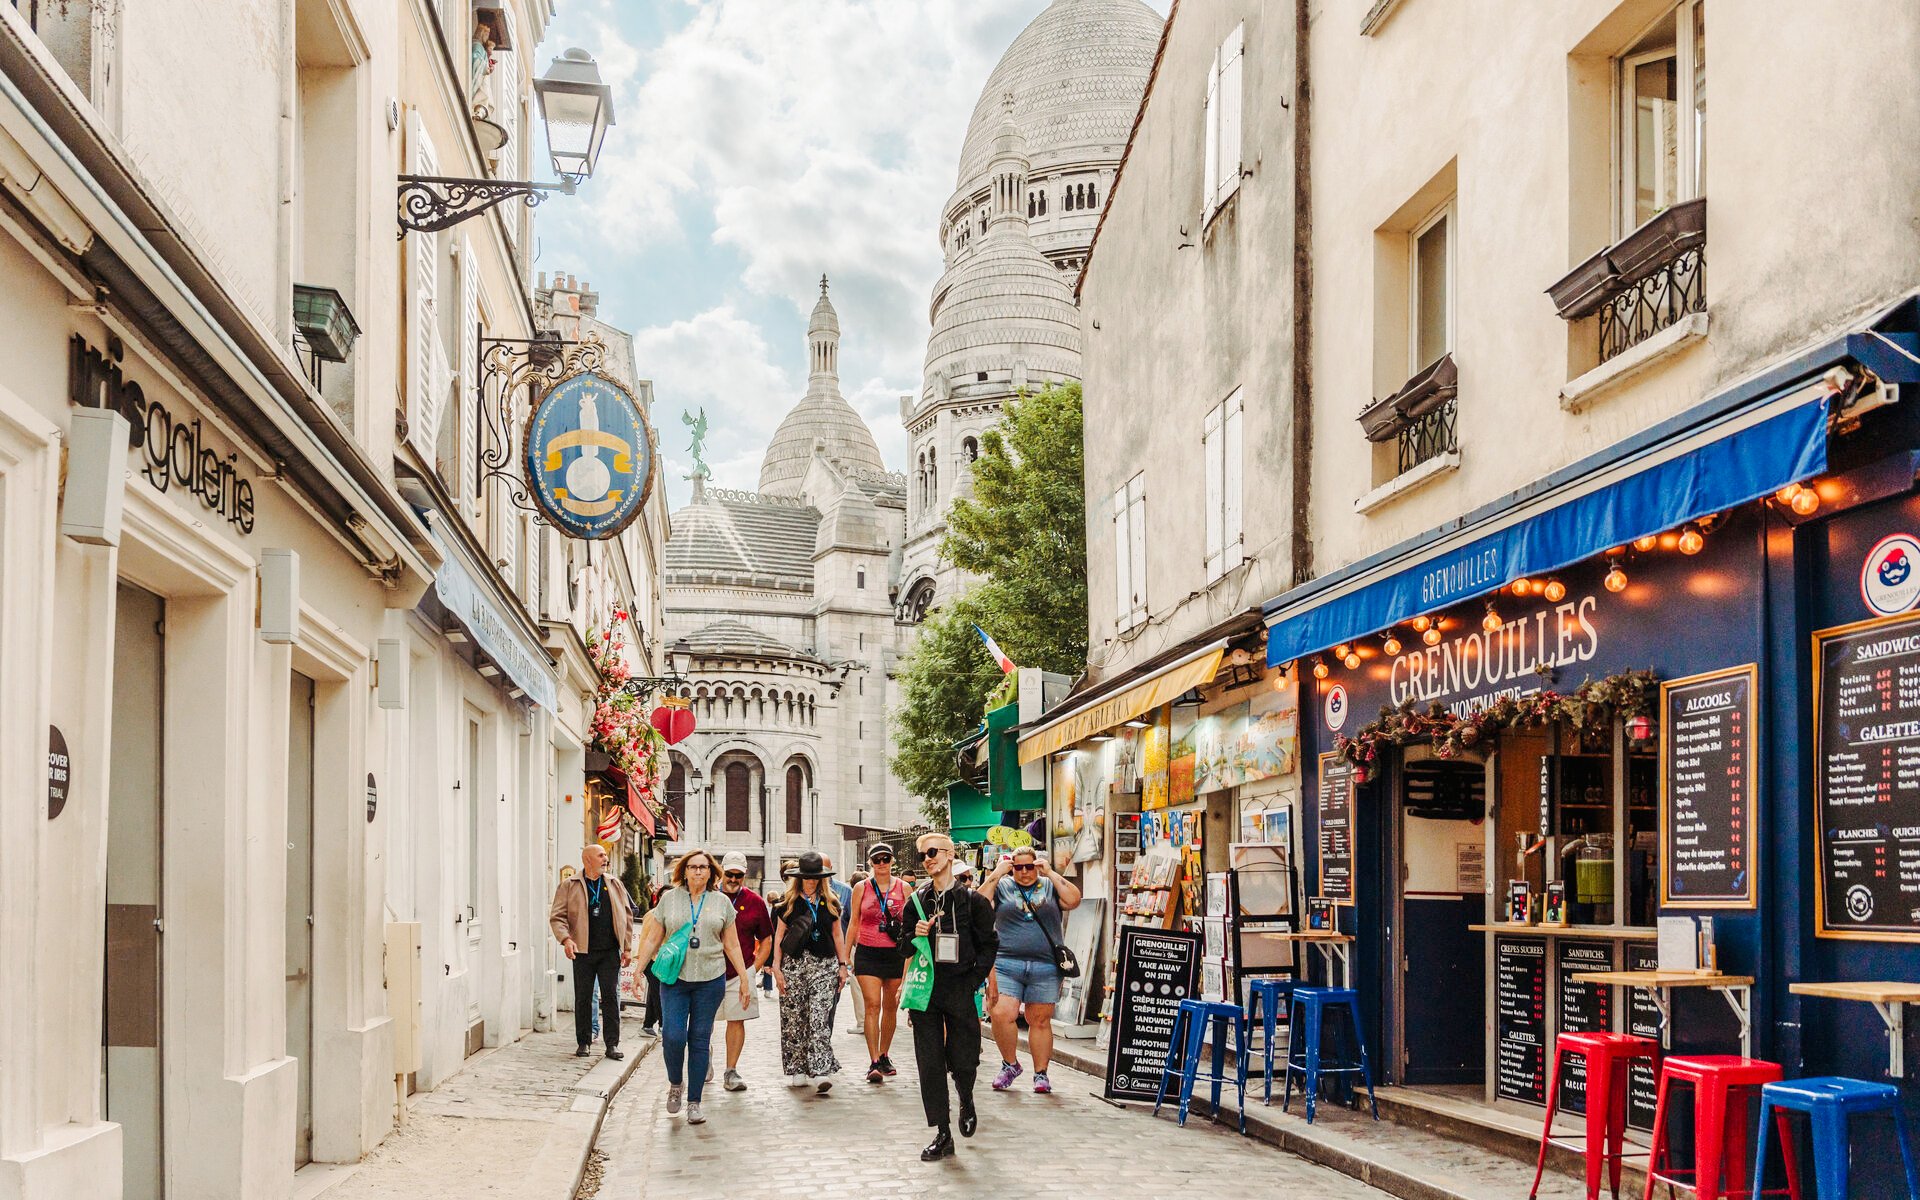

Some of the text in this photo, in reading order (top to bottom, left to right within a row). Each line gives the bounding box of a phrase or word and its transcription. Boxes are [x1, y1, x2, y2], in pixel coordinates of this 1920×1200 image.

[1422, 548, 1497, 603] GRENOUILLES
[1390, 596, 1598, 706] GRENOUILLES
[1857, 635, 1920, 660] SANDWIC
[1686, 692, 1731, 711] ALCOOLS
[54, 768, 67, 782] IRIS
[50, 786, 64, 799] TRIAL
[1839, 829, 1878, 839] PLANCHES
[1136, 939, 1187, 952] GRENOUILLES
[1568, 949, 1605, 960] SANDWICHS
[1138, 961, 1182, 973] TAKE AWAY
[1145, 972, 1172, 981] ON SITE
[1132, 995, 1155, 1005] CRÊPE
[1133, 1005, 1179, 1017] CRÊPE SALEE
[1135, 1016, 1174, 1026] SANDWICH
[1136, 1025, 1171, 1035] RACLETTE
[1633, 1023, 1657, 1034] Galettes
[1509, 1031, 1536, 1042] GALETTES
[1132, 1038, 1169, 1049] SMOOTHIE
[1122, 1048, 1144, 1056] BIERE
[1134, 1057, 1166, 1066] SANGRIA
